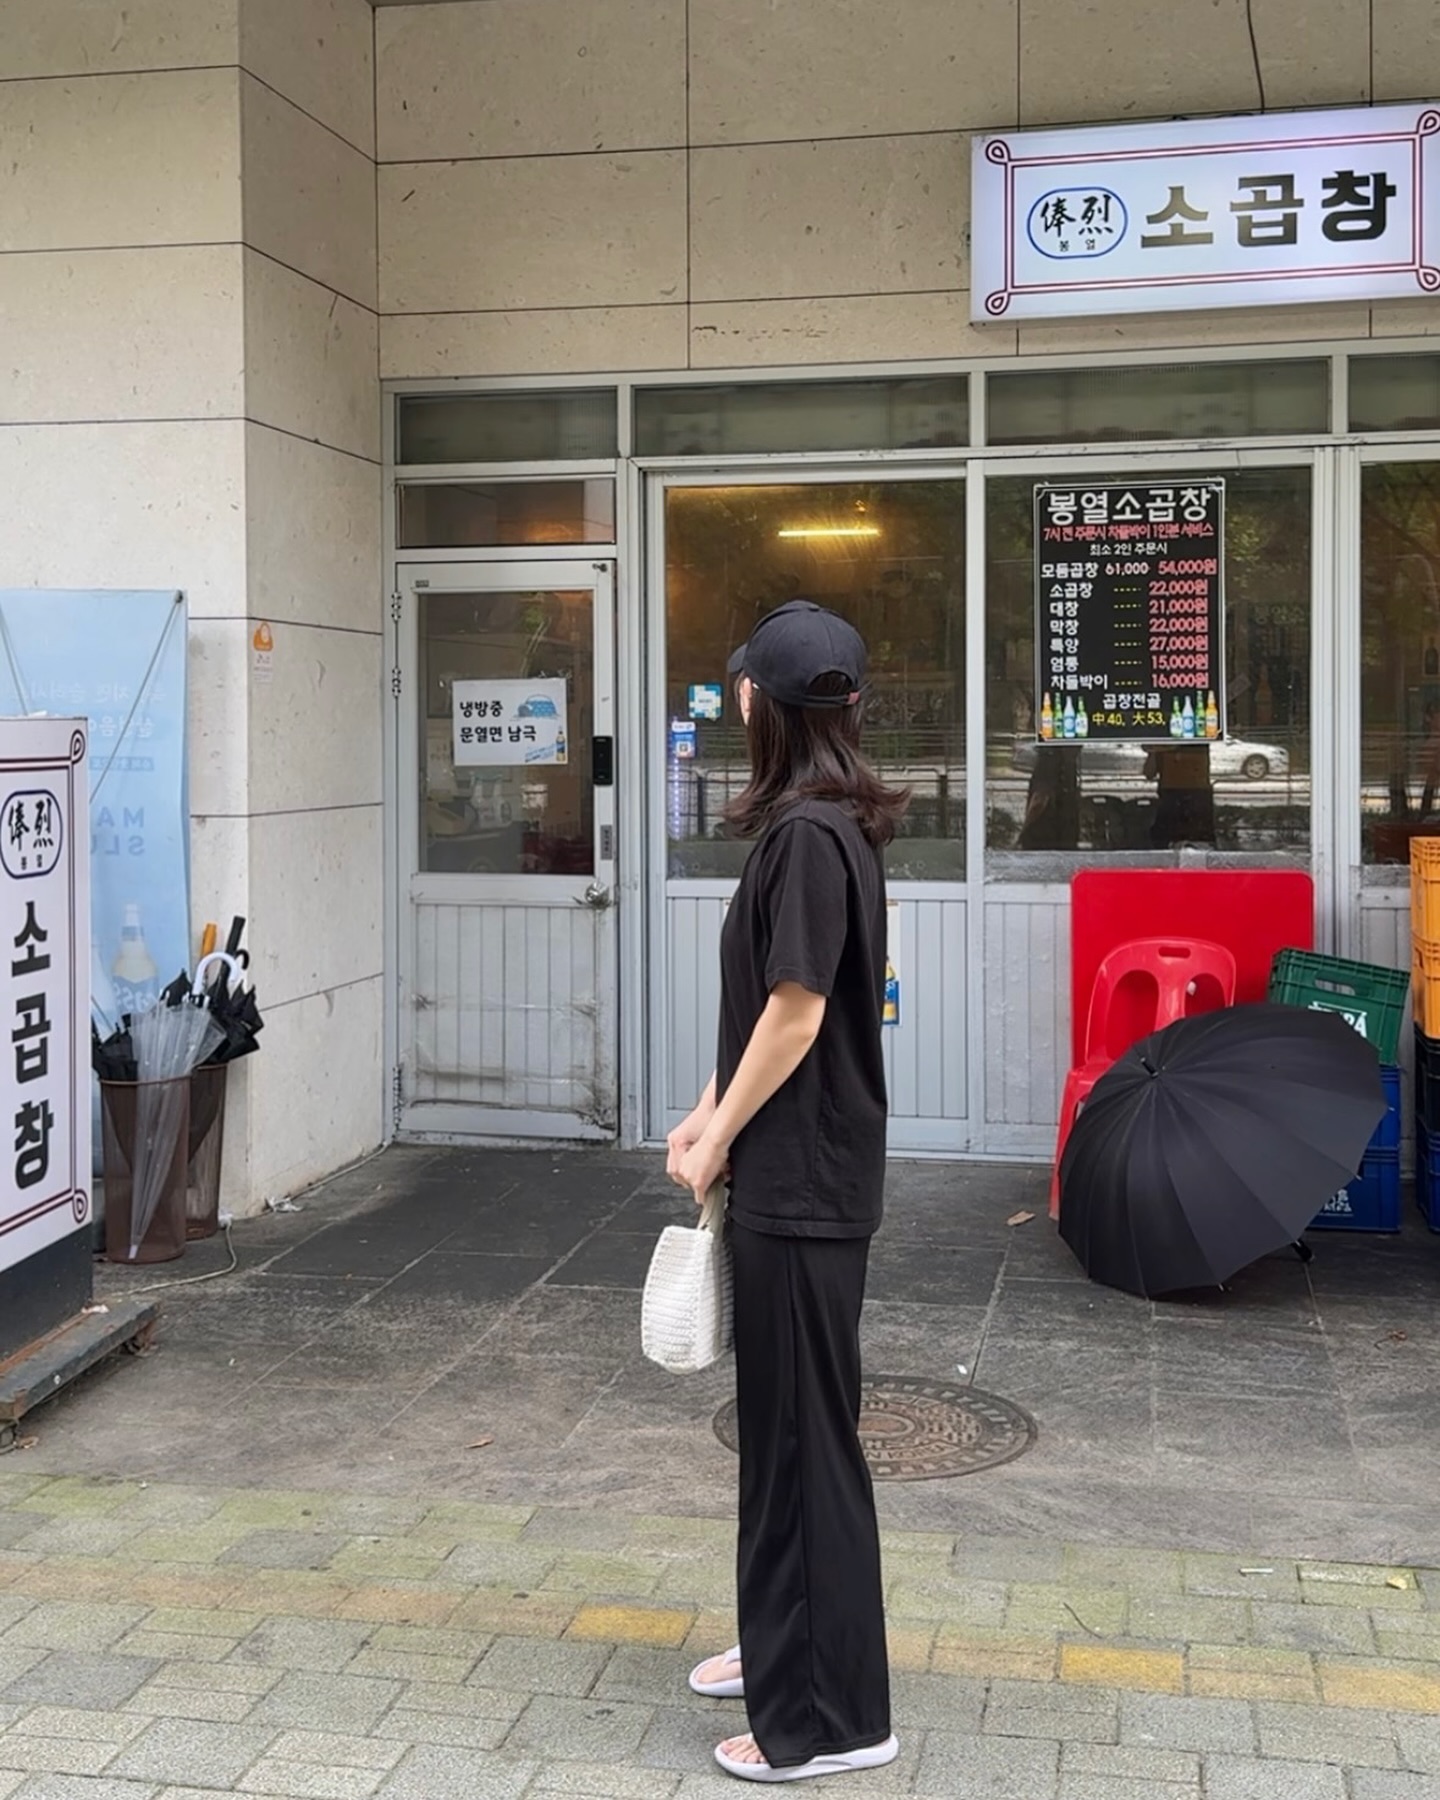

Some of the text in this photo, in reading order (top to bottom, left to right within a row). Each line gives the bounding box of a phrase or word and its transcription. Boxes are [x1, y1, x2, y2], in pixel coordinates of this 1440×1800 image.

[1140, 169, 1396, 248] 소곱창
[1047, 488, 1211, 525] 봉열소곱창
[1090, 541, 1168, 556] 최소 2인 주문시
[1105, 562, 1149, 577] 61,000
[1158, 558, 1217, 576] 54,000원
[1049, 578, 1208, 599] 소곱창 22,000원
[1049, 597, 1208, 617] 대창 21,000원
[1050, 616, 1208, 635] 막창 22,000원
[1149, 635, 1208, 652] 27,000원
[1152, 653, 1208, 671] 15,000원
[1051, 672, 1209, 690] 차돌박이 16,000원
[460, 700, 503, 718] 냉방중
[1103, 692, 1161, 709] 곱창전골
[460, 725, 537, 743] 문열면 남극
[11, 900, 54, 1190] 소곱창
